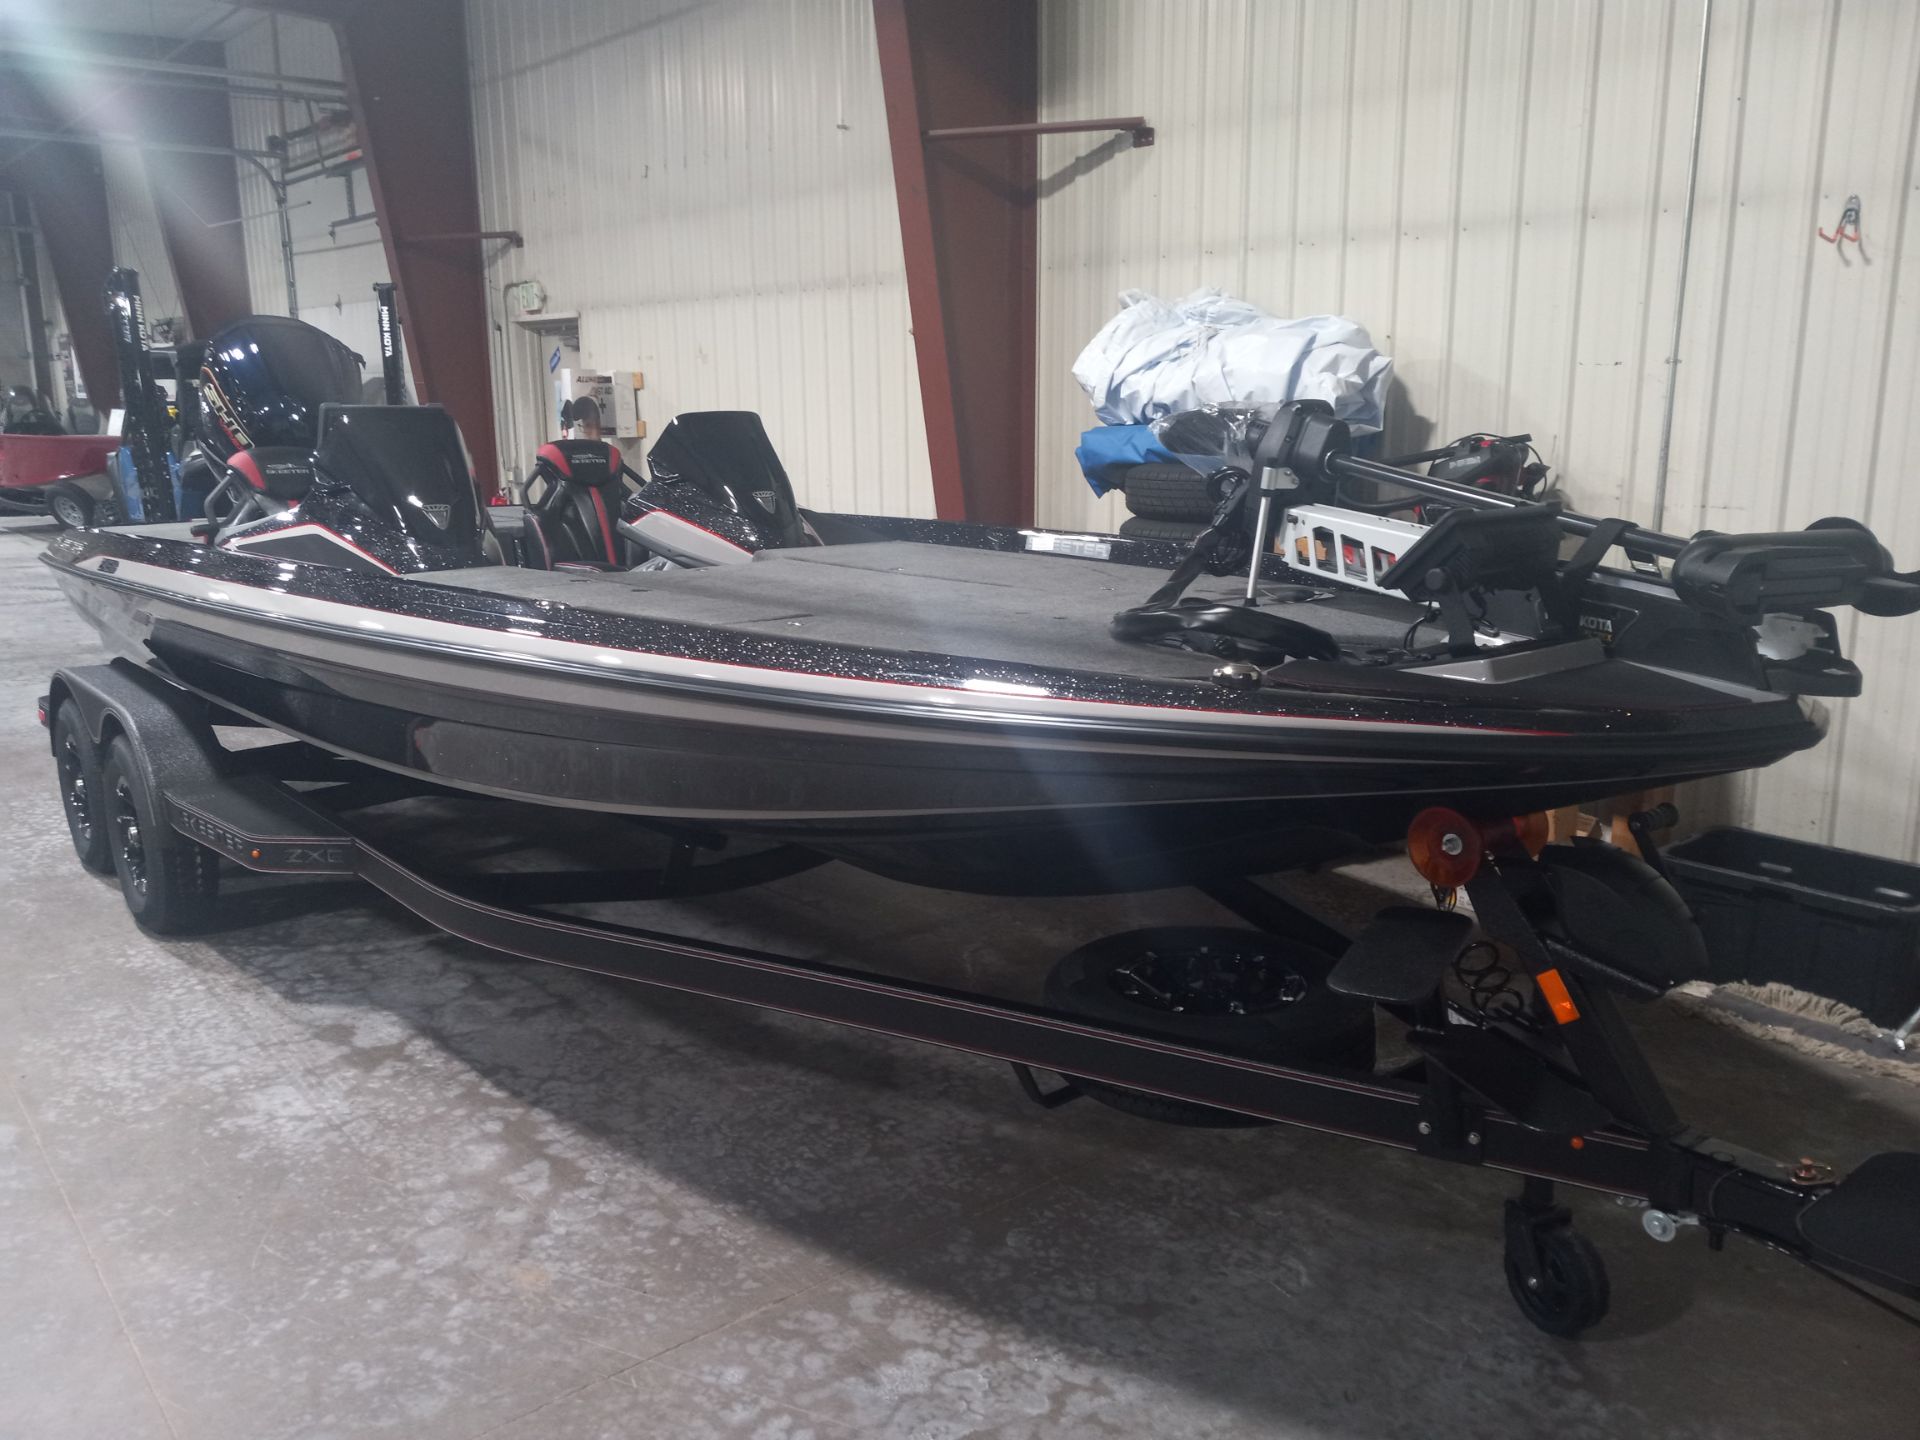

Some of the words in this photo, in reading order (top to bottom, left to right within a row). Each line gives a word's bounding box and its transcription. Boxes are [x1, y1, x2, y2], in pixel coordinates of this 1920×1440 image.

[133, 294, 145, 323] MINN
[380, 306, 391, 331] MINN
[137, 323, 149, 352] KOTA
[383, 332, 393, 357] KOTA
[1579, 615, 1613, 633] KOTA
